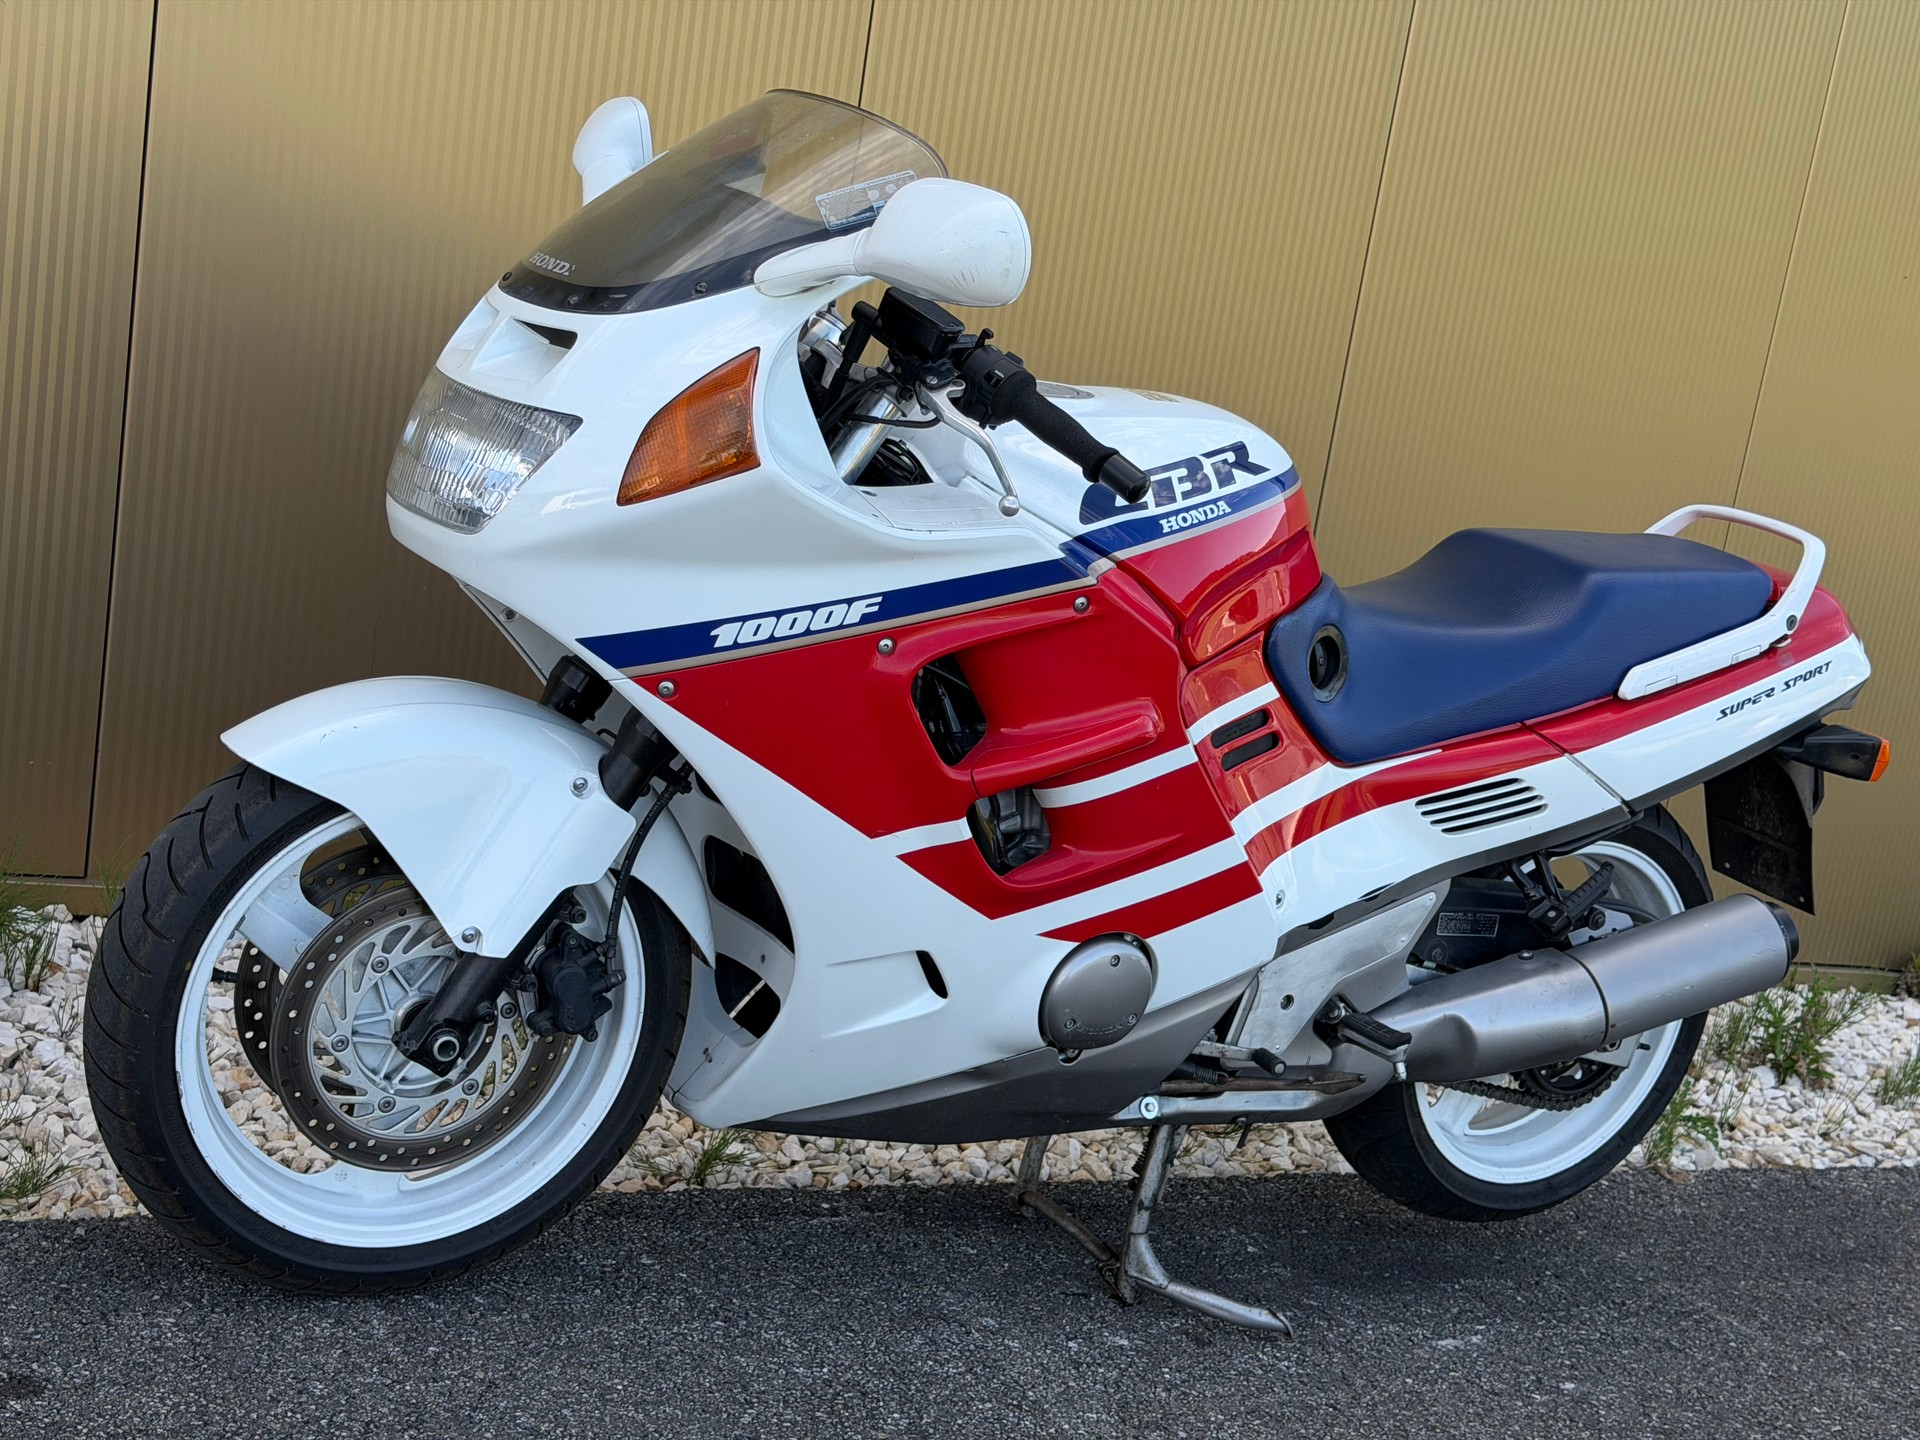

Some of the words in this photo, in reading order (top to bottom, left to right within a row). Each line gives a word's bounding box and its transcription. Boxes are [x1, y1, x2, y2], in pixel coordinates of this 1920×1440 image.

[1159, 501, 1232, 533] HONDA
[709, 596, 883, 648] 1000F
[1716, 687, 1776, 721] SUPER
[1781, 660, 1832, 692] SPORT
